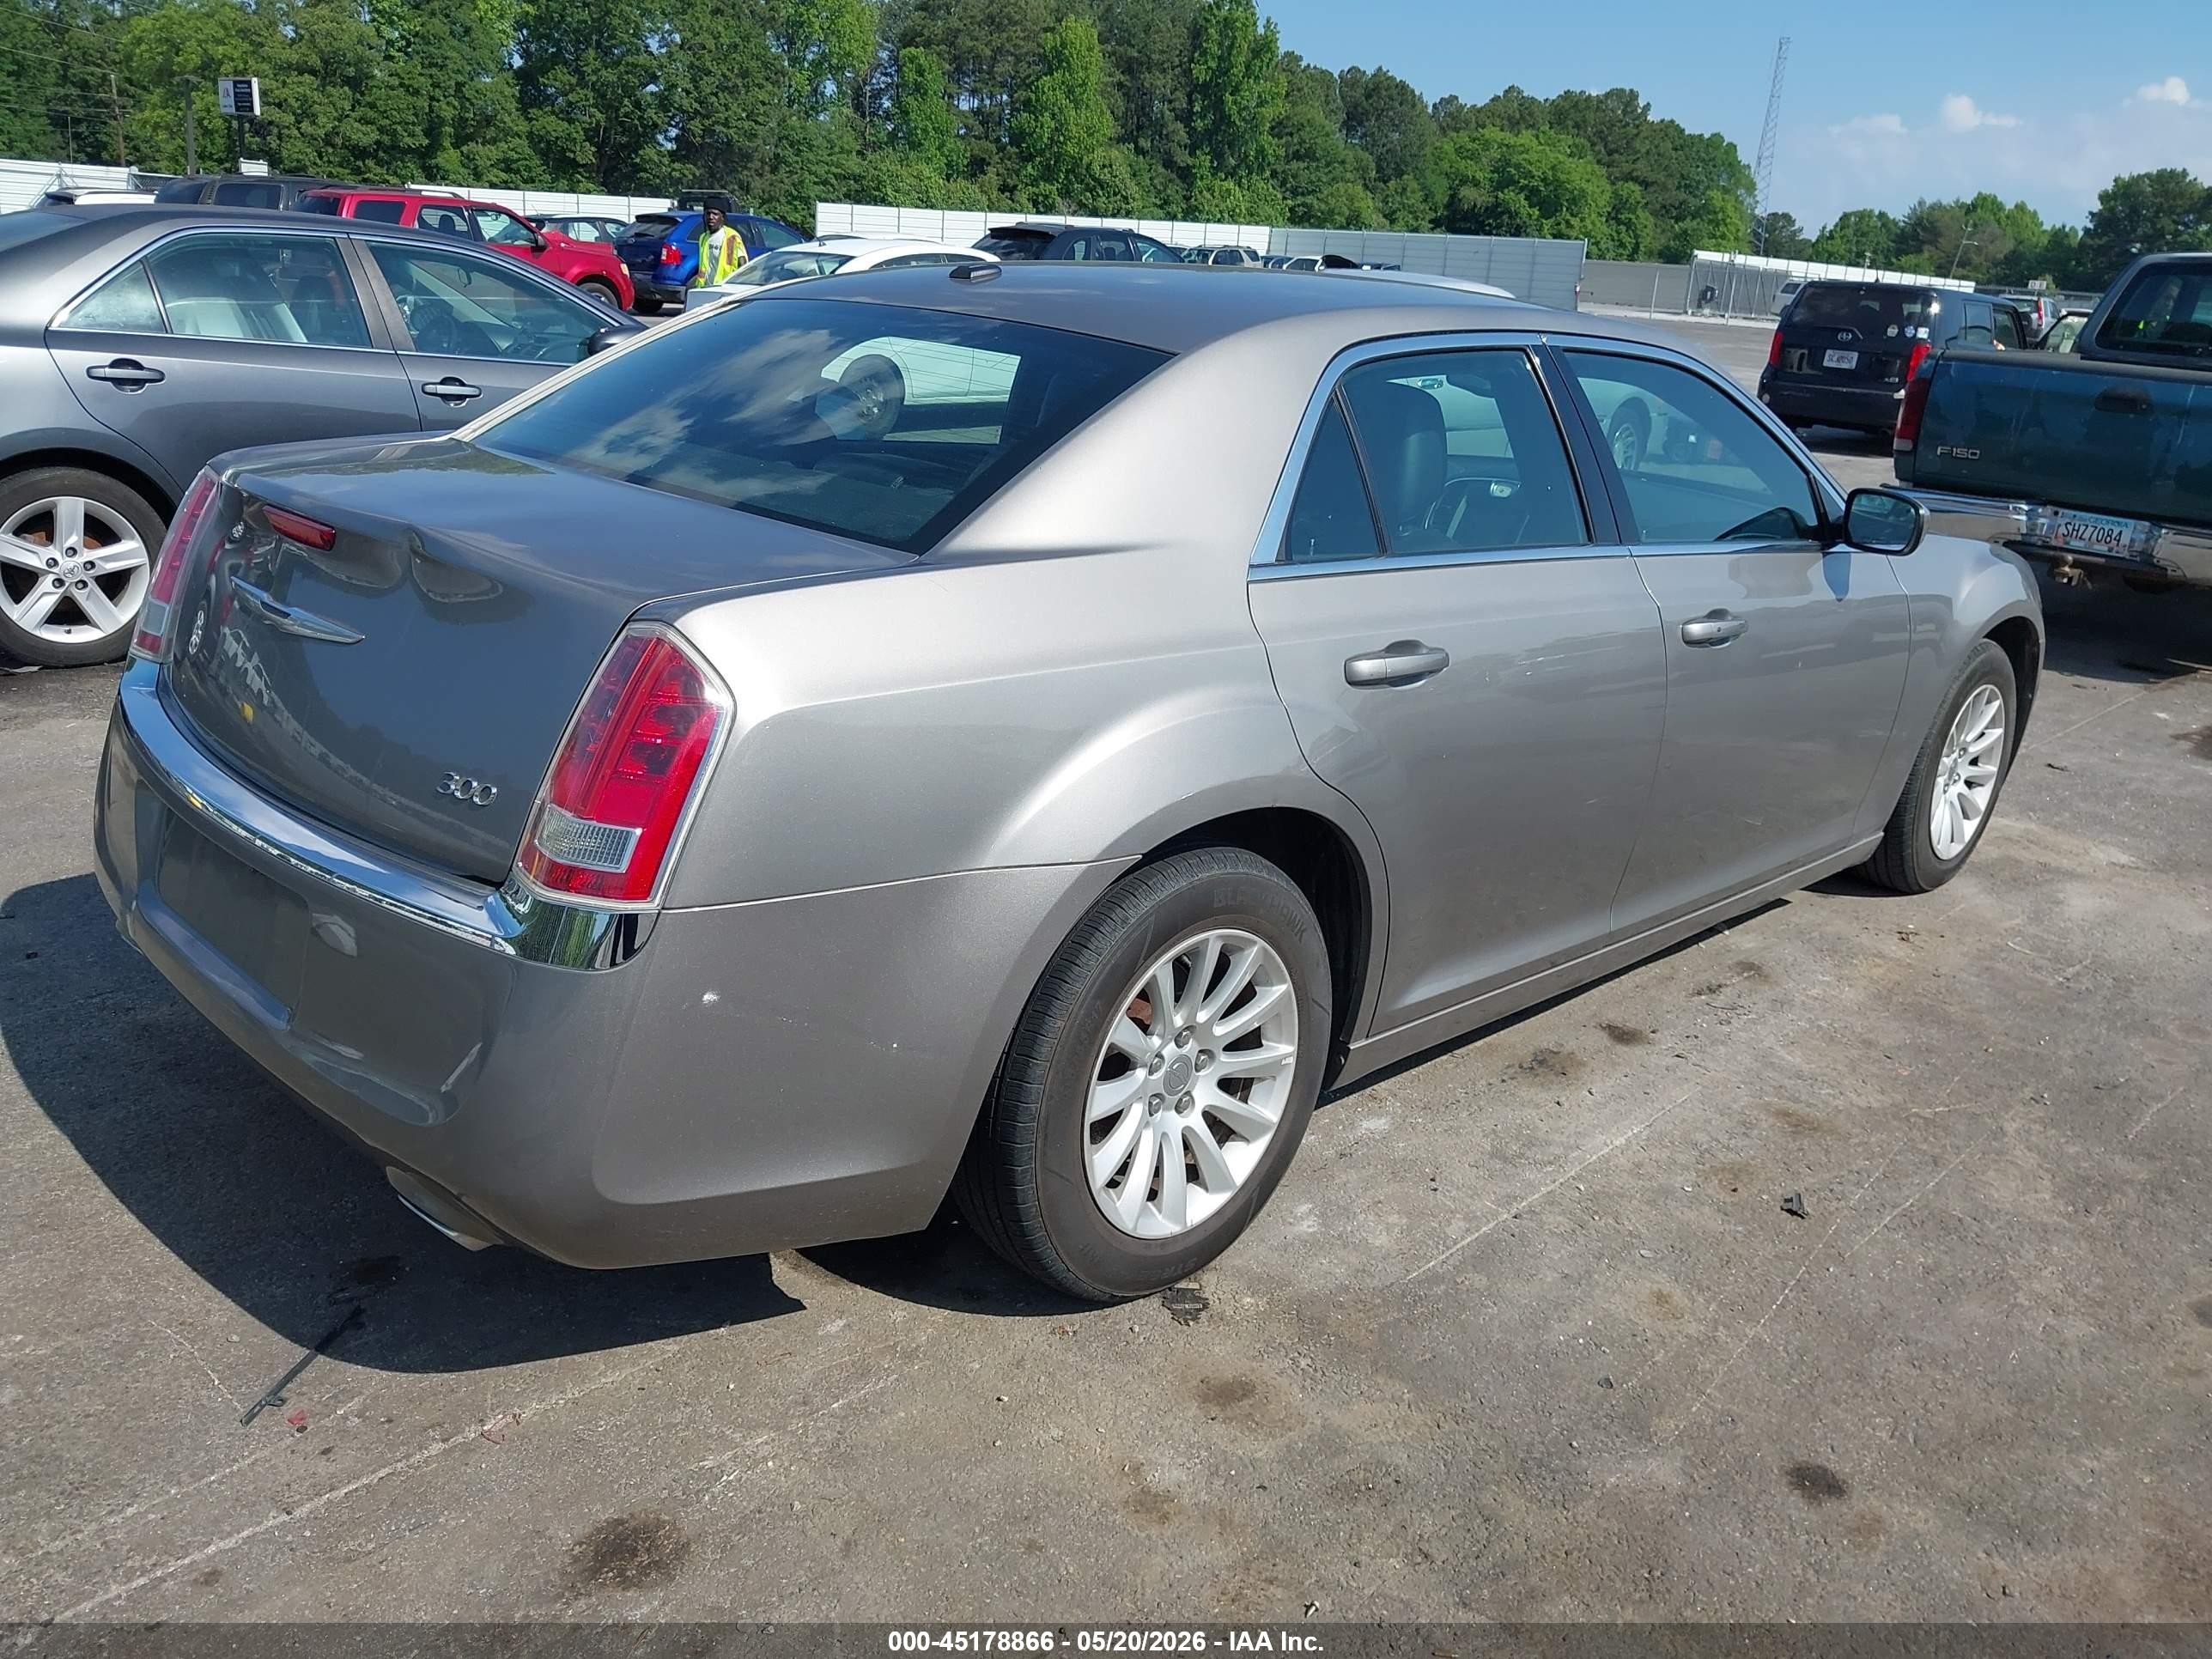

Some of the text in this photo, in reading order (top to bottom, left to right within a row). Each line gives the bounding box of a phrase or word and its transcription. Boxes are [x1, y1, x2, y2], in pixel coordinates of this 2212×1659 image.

[1936, 446, 1981, 459] F150
[2062, 521, 2124, 547] SHZ7084
[435, 771, 498, 805] 300
